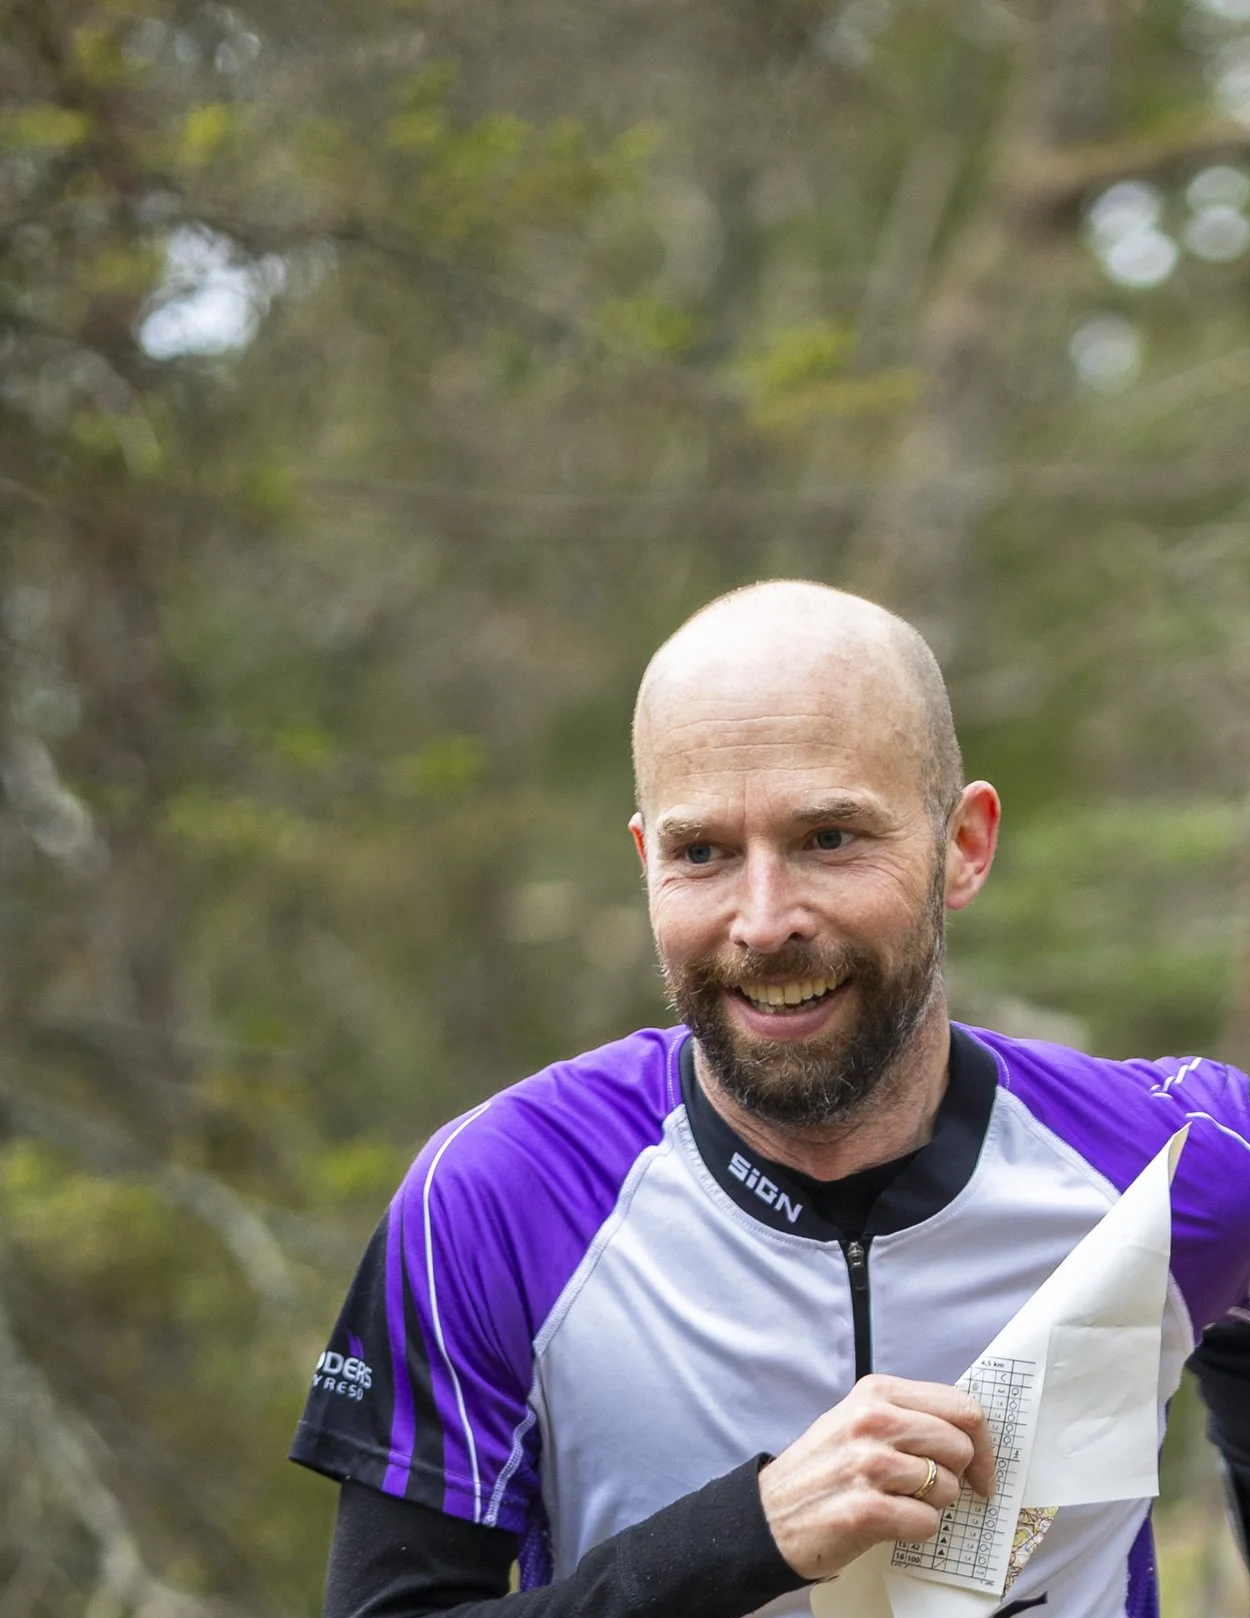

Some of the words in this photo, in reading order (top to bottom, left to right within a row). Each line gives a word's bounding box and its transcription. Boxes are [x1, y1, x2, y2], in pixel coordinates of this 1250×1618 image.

[316, 1351, 373, 1389] DERS
[896, 1552, 905, 1560] 16
[907, 1555, 920, 1563] 100
